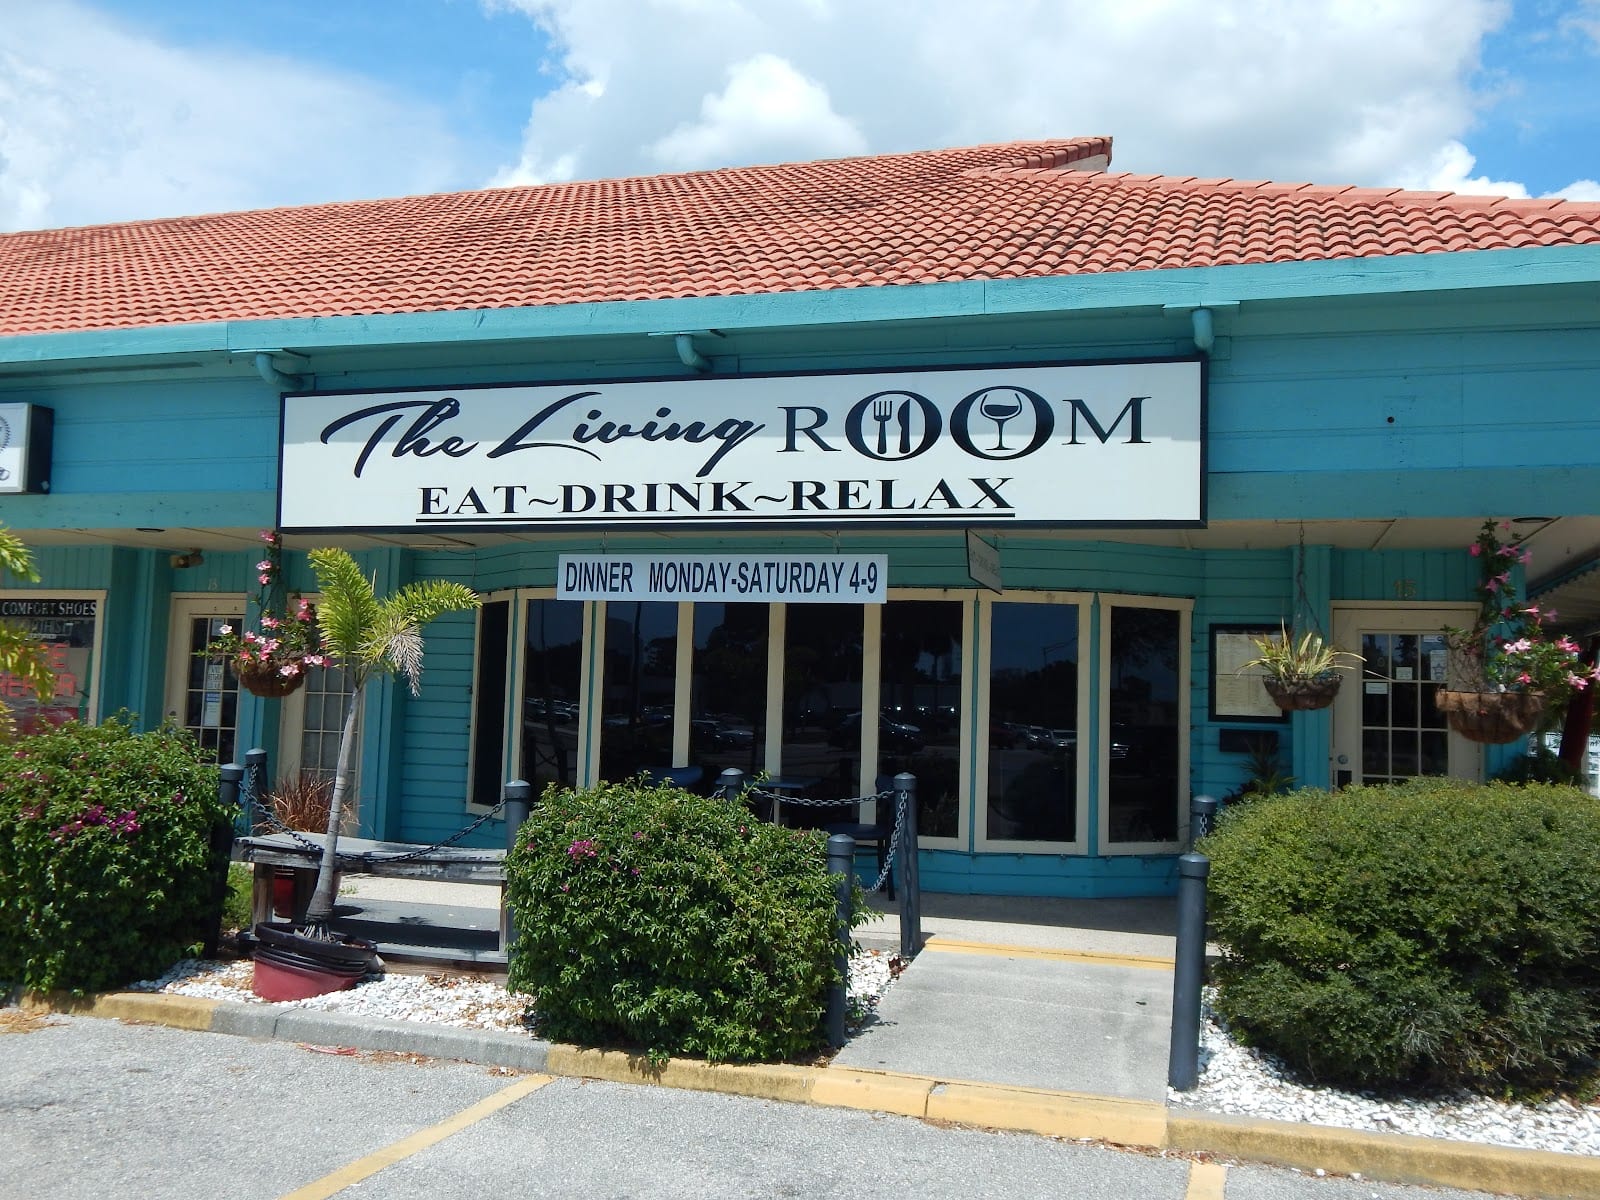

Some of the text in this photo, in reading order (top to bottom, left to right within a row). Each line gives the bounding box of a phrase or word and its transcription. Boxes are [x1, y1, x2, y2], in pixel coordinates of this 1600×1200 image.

[320, 385, 1153, 478] The Living ROOM
[565, 561, 878, 594] DINNER MONDAY-SATURDAY 4-9
[2, 601, 97, 616] COMFORT SHOES
